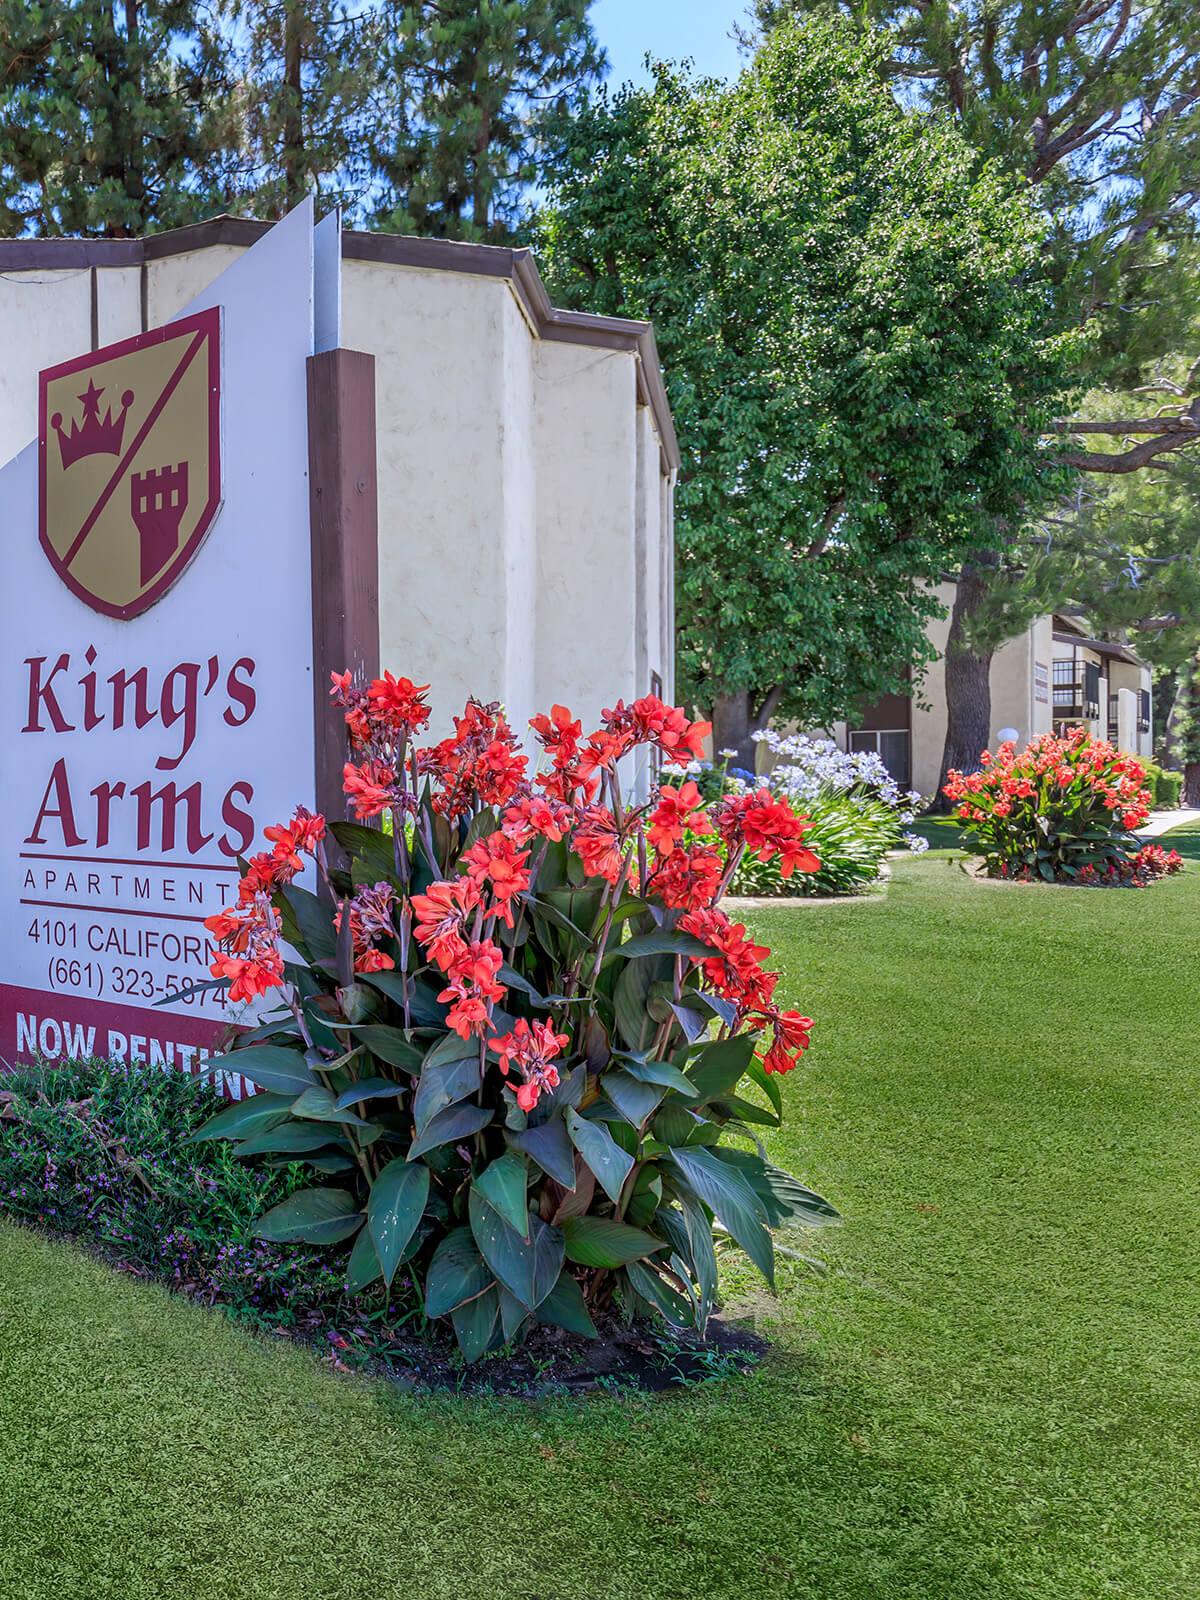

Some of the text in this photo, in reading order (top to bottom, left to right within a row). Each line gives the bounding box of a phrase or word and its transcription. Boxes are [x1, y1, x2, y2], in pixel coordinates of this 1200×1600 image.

[20, 643, 256, 771] King's
[23, 757, 255, 857] Arms
[24, 868, 233, 906] APARTMENT
[27, 917, 78, 948] 4101
[48, 956, 229, 1010] (661) 323-5874
[16, 1012, 97, 1061] NOW
